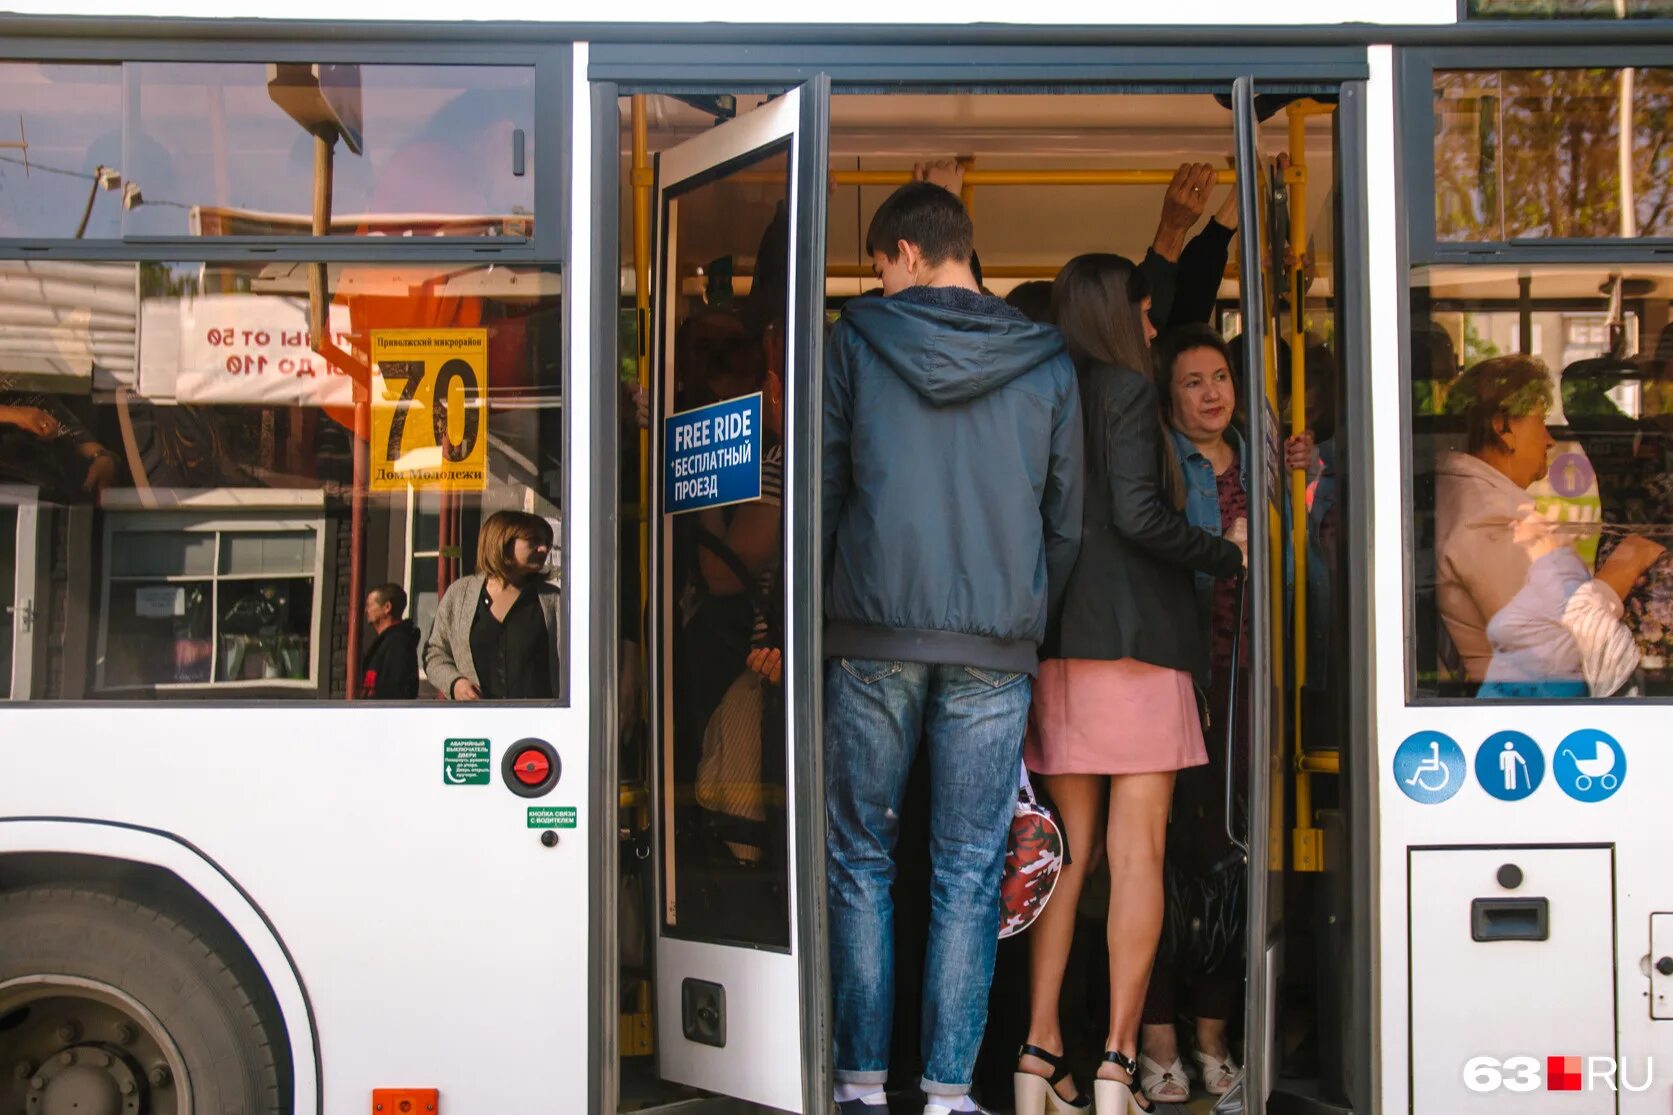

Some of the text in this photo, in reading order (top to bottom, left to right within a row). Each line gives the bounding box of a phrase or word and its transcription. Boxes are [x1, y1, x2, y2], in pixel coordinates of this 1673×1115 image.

[377, 337, 482, 349] Приволжский микрорайон
[377, 358, 480, 463] 70
[675, 409, 752, 452] FREE RIDE
[376, 468, 482, 481] Дом Молодежи
[674, 439, 752, 478] БЕСПЛАТНЫЙ
[674, 474, 718, 501] ПРОЕЗД
